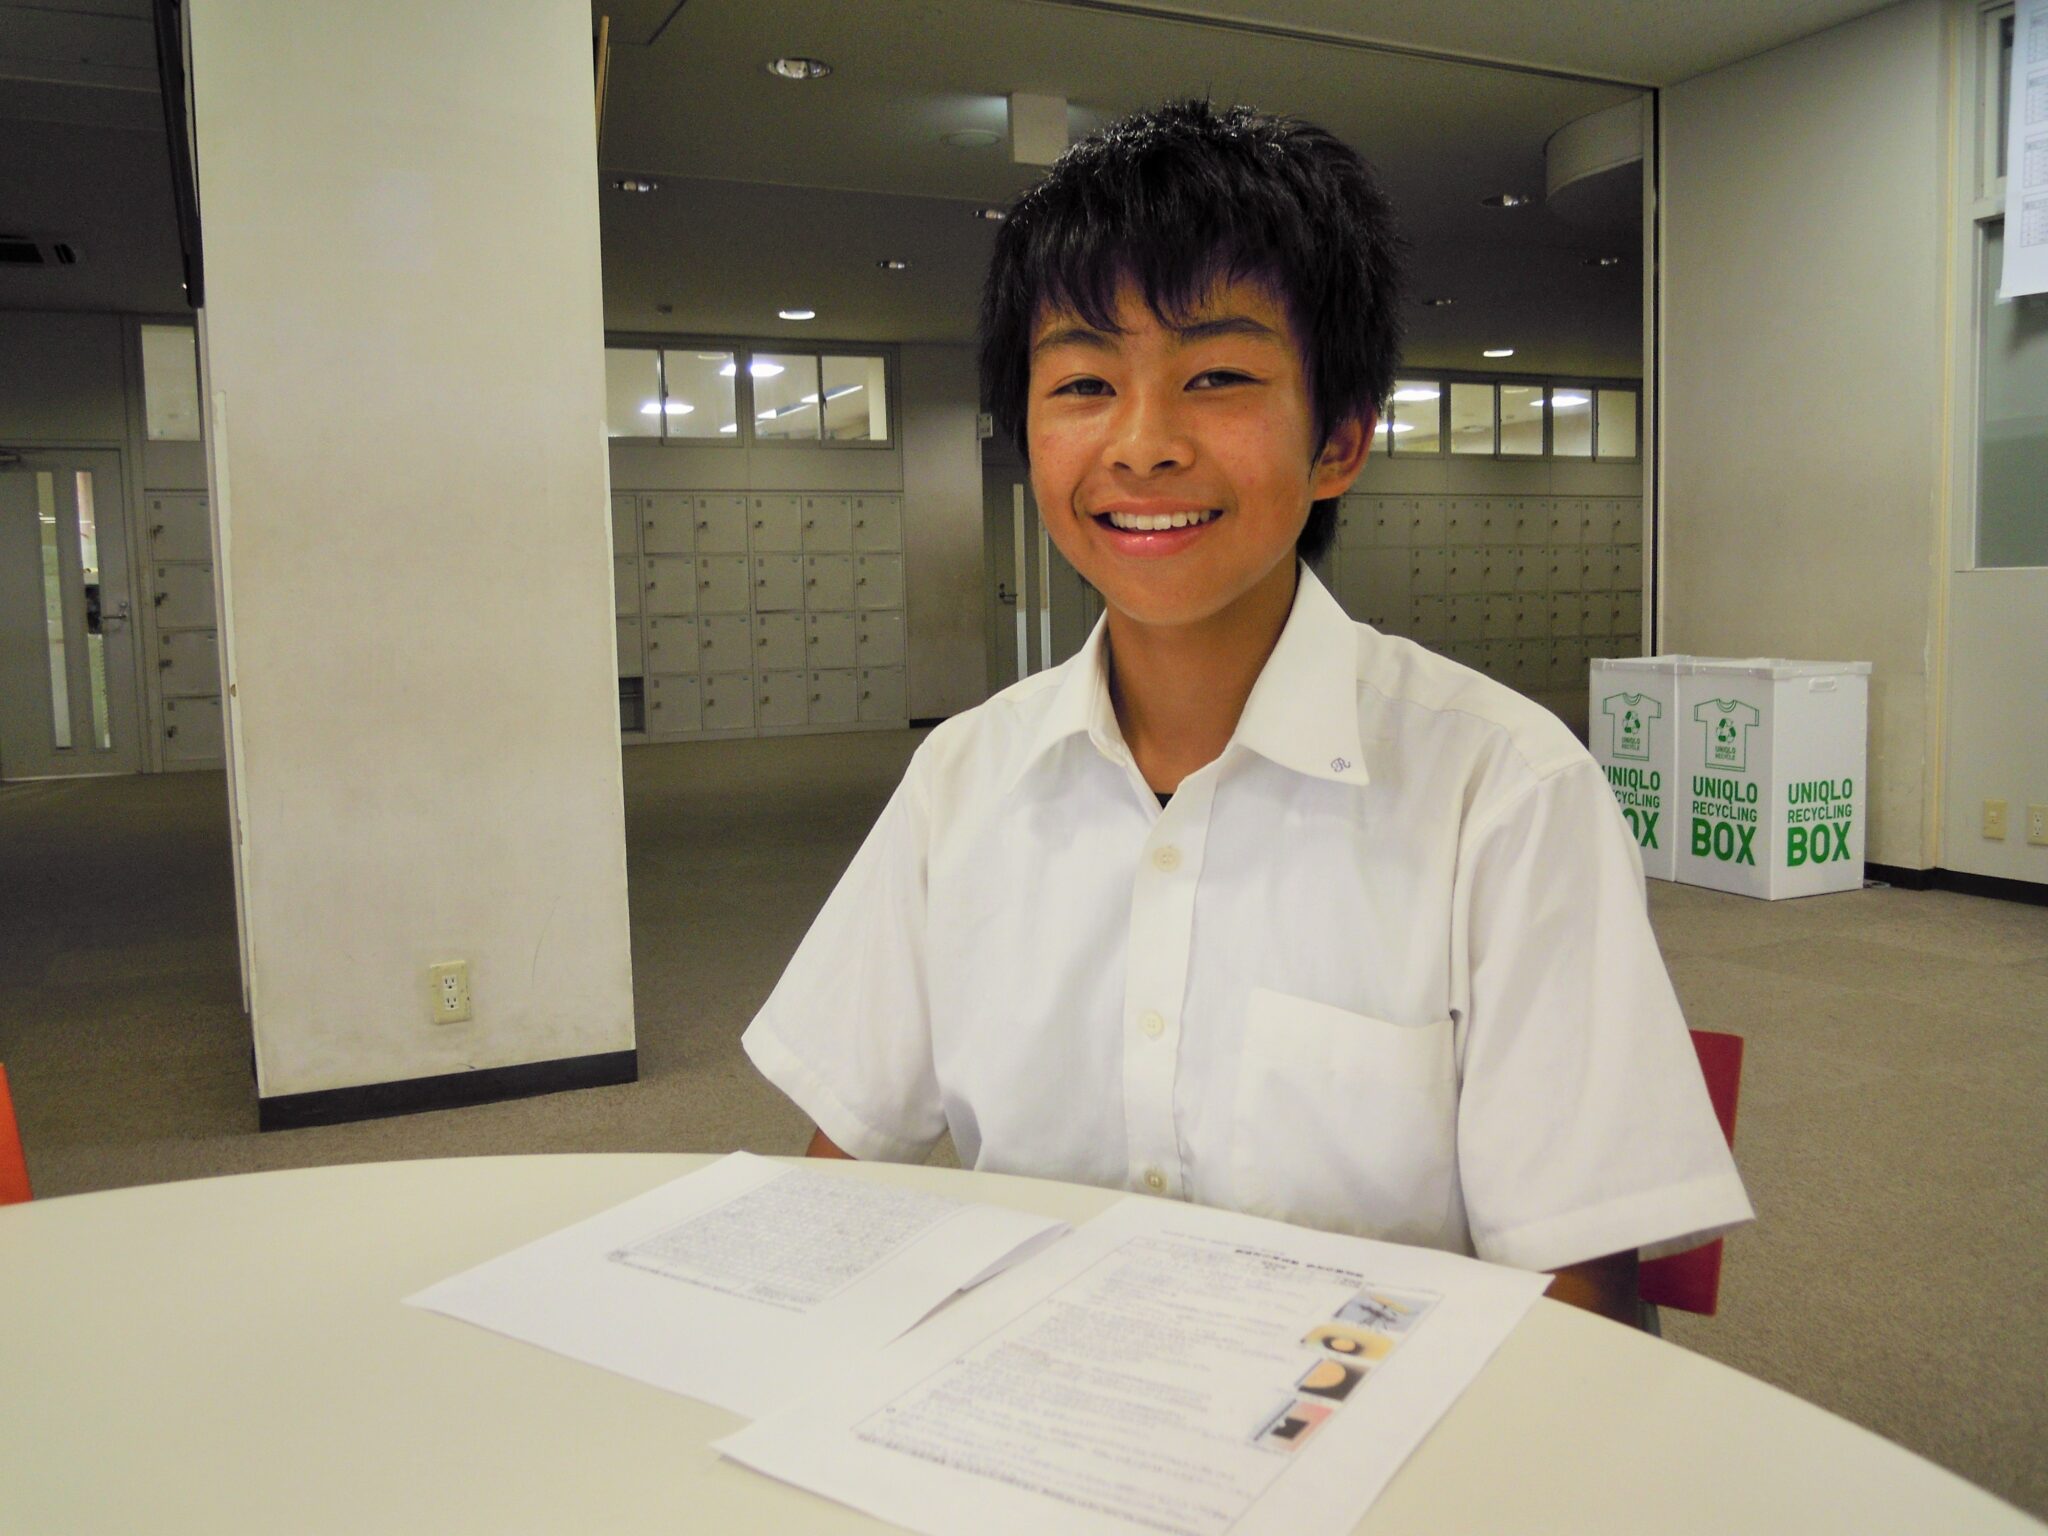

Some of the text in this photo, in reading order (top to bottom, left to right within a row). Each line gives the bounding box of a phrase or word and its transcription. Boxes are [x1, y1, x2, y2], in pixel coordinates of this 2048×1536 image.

[1613, 789, 1660, 809] CYCLING
[1692, 775, 1758, 805] UNIQLO
[1788, 778, 1853, 806] UNIQLO
[1692, 800, 1758, 823] RECYCLING
[1787, 803, 1852, 824] RECYCLING
[1622, 807, 1660, 850] OX
[1691, 816, 1757, 867] BOX
[1786, 820, 1852, 867] BOX
